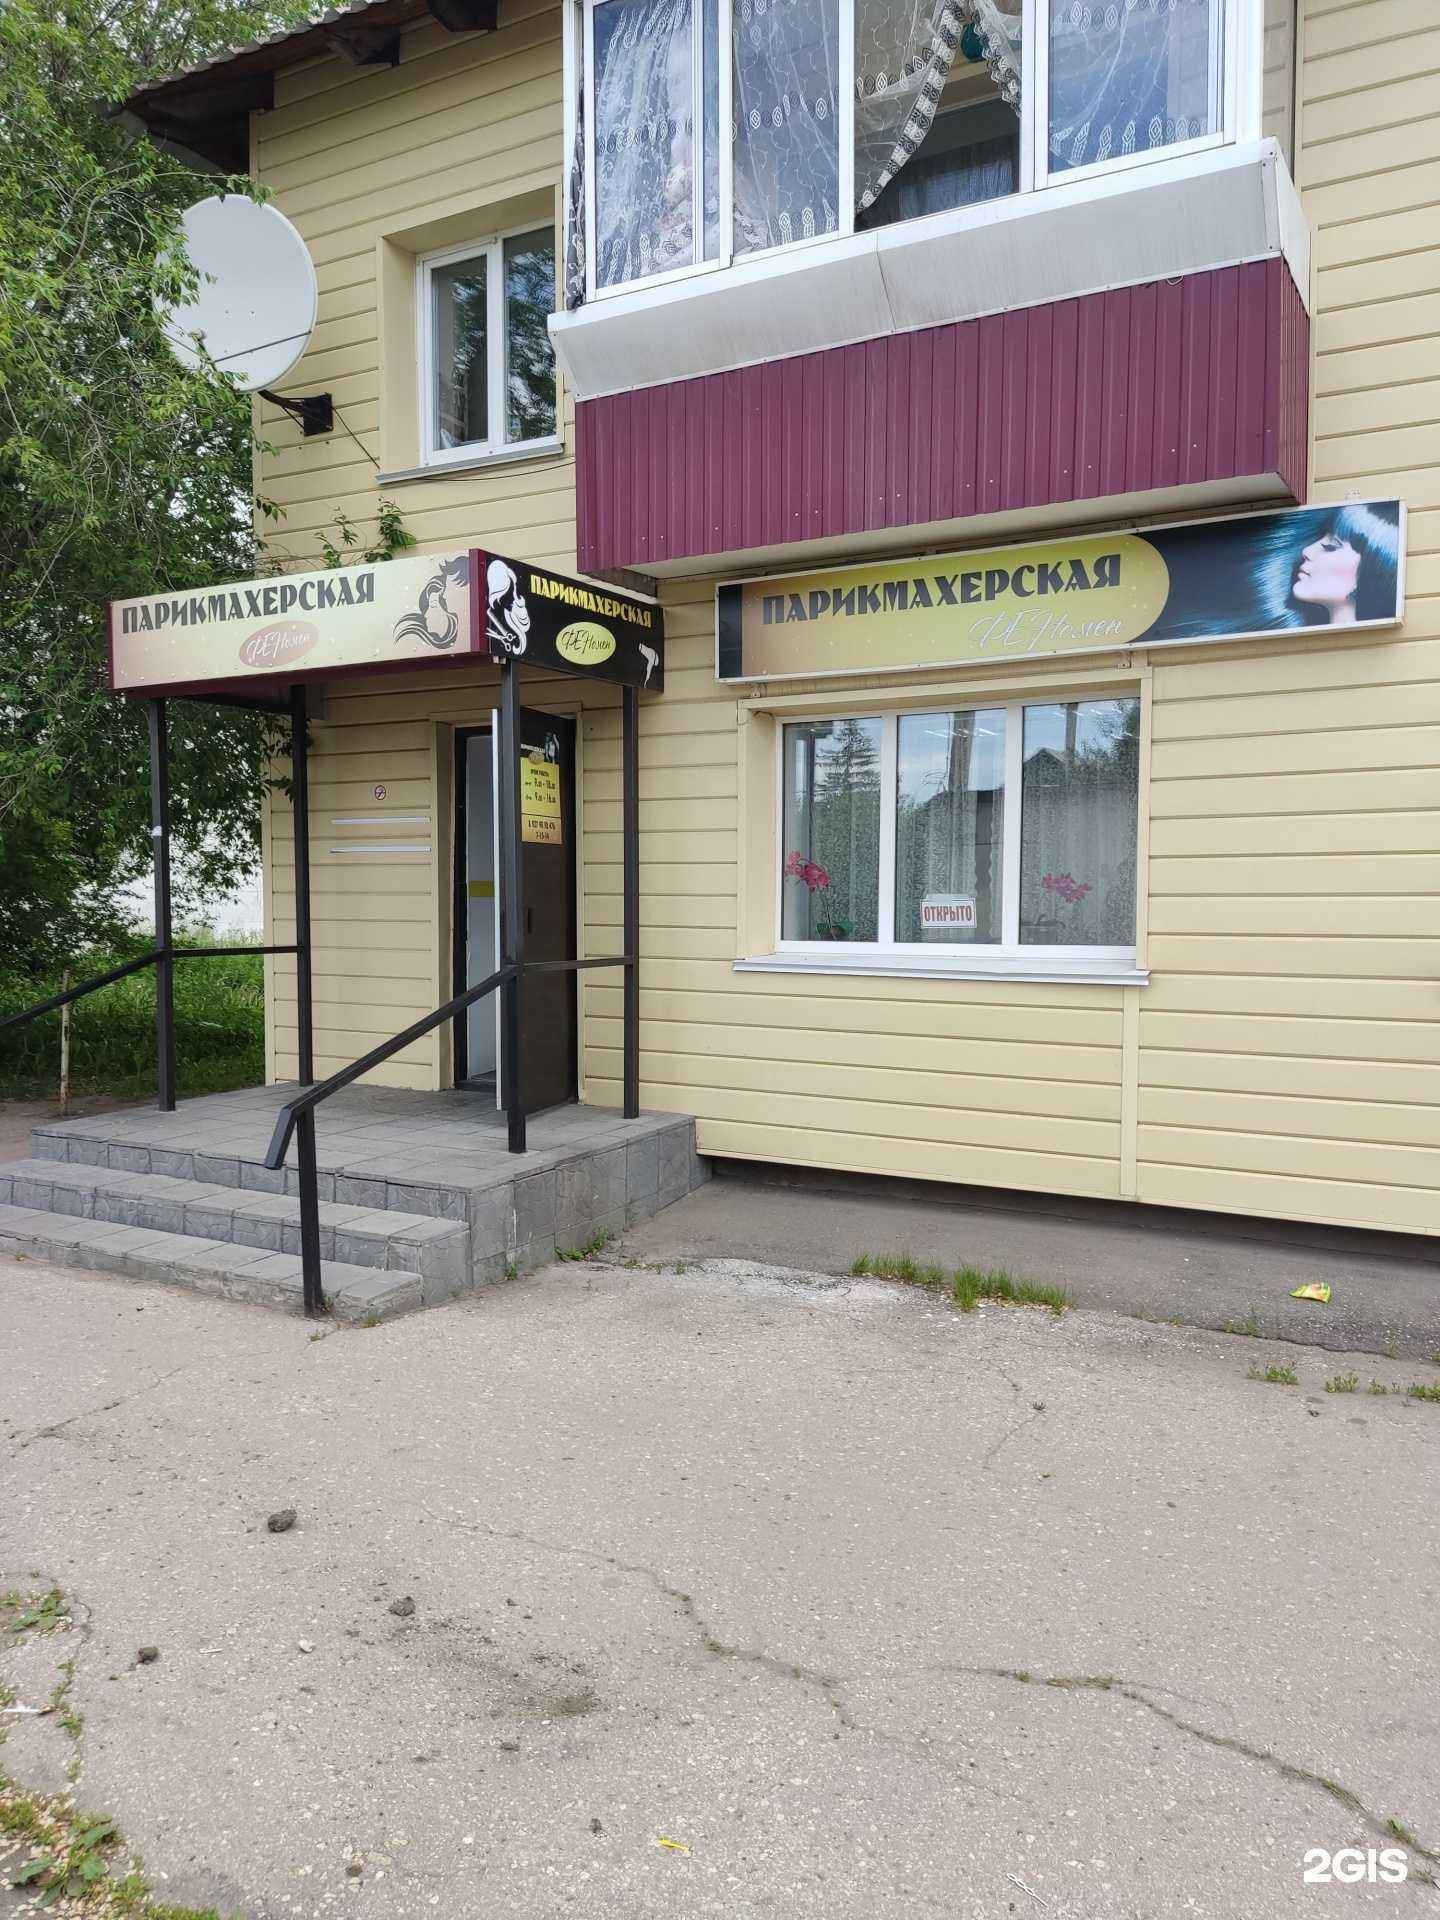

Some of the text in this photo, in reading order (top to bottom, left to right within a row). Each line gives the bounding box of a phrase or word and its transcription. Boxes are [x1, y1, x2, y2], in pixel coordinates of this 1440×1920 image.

[122, 573, 375, 634] ПАРИКМАХЕРСКАЯ
[530, 574, 652, 629] ПАРИКМАХЕРСКАЯ
[762, 554, 1121, 625] ПАРИКМАХЕРСКАЯ
[924, 905, 972, 921] ОТКРЫТО
